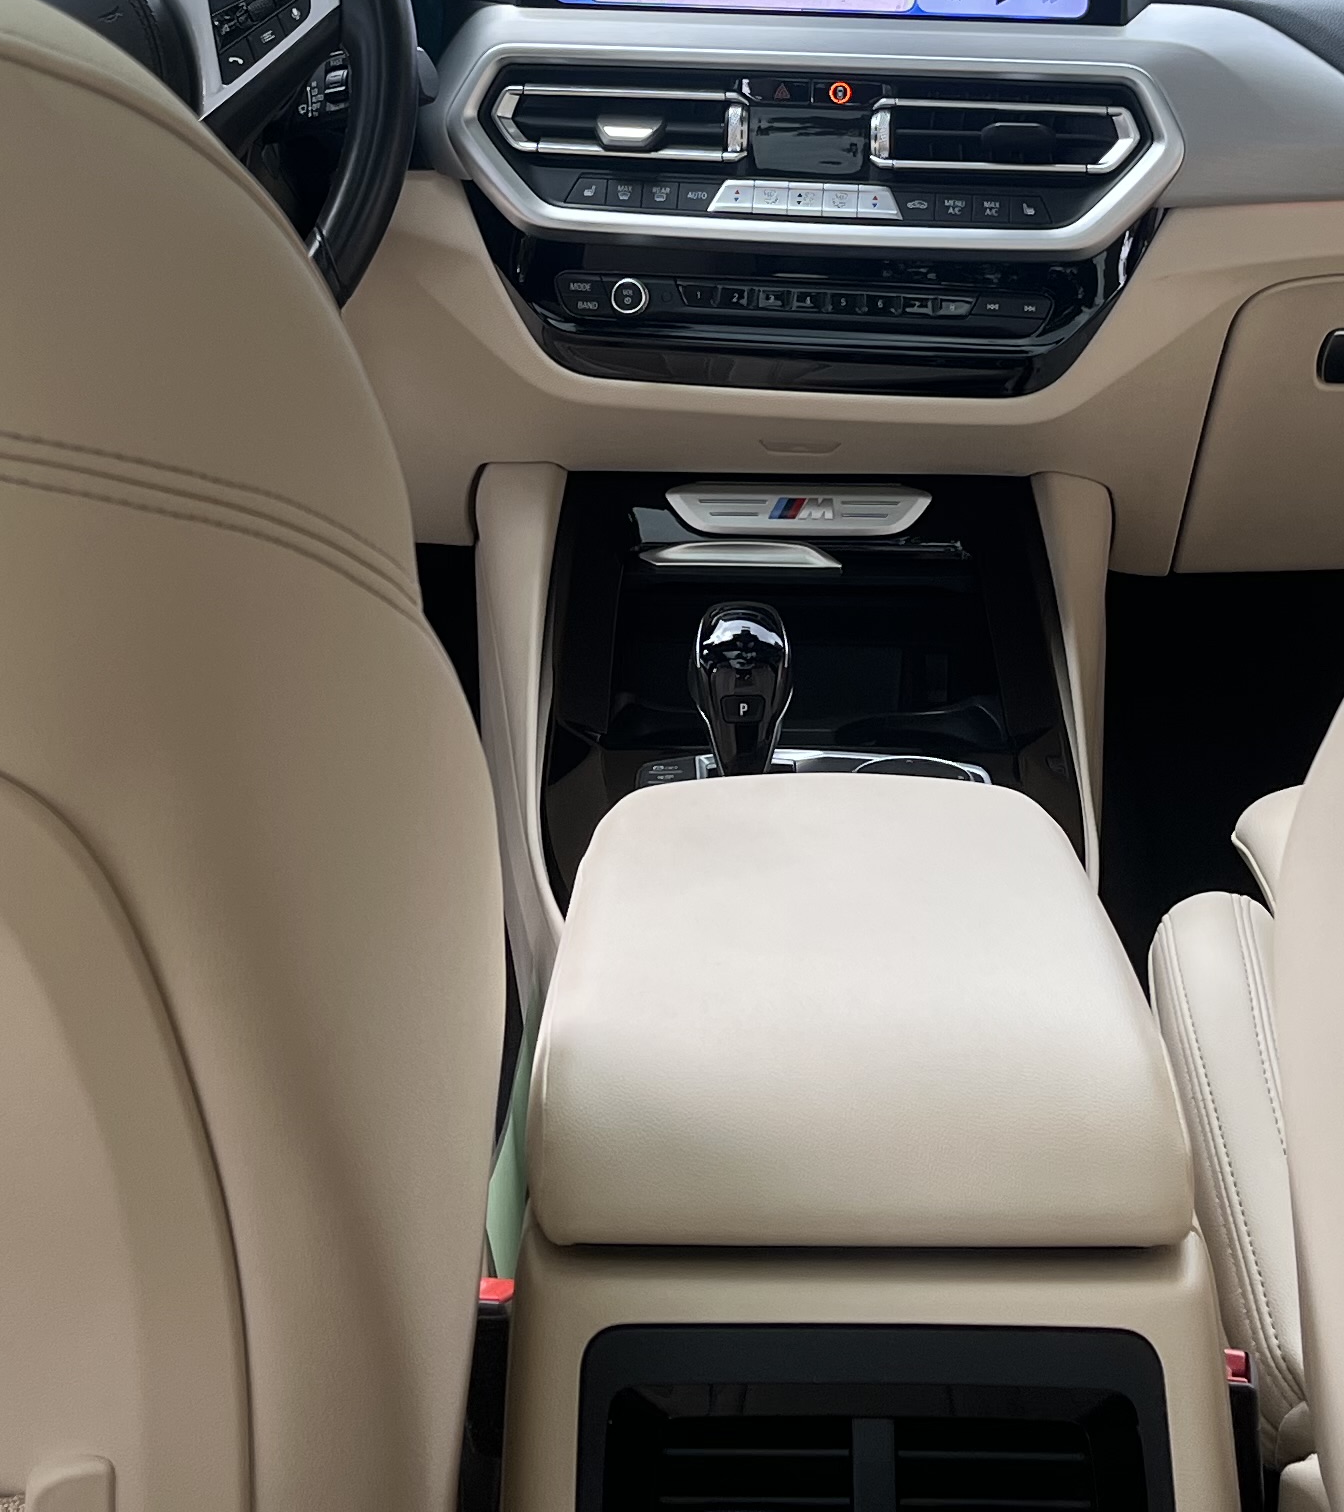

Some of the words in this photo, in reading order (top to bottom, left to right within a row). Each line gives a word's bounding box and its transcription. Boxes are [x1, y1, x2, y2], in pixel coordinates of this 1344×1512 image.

[687, 191, 708, 200] AUTO
[944, 199, 966, 208] MENU
[983, 200, 1000, 208] MAX
[947, 206, 962, 215] A/C
[984, 208, 999, 216] A/C
[569, 282, 592, 292] MODE
[731, 293, 739, 303] 2
[840, 297, 847, 306] 5
[577, 301, 599, 310] BAND
[877, 299, 884, 308] 6
[796, 496, 835, 521] M
[739, 702, 749, 717] P
